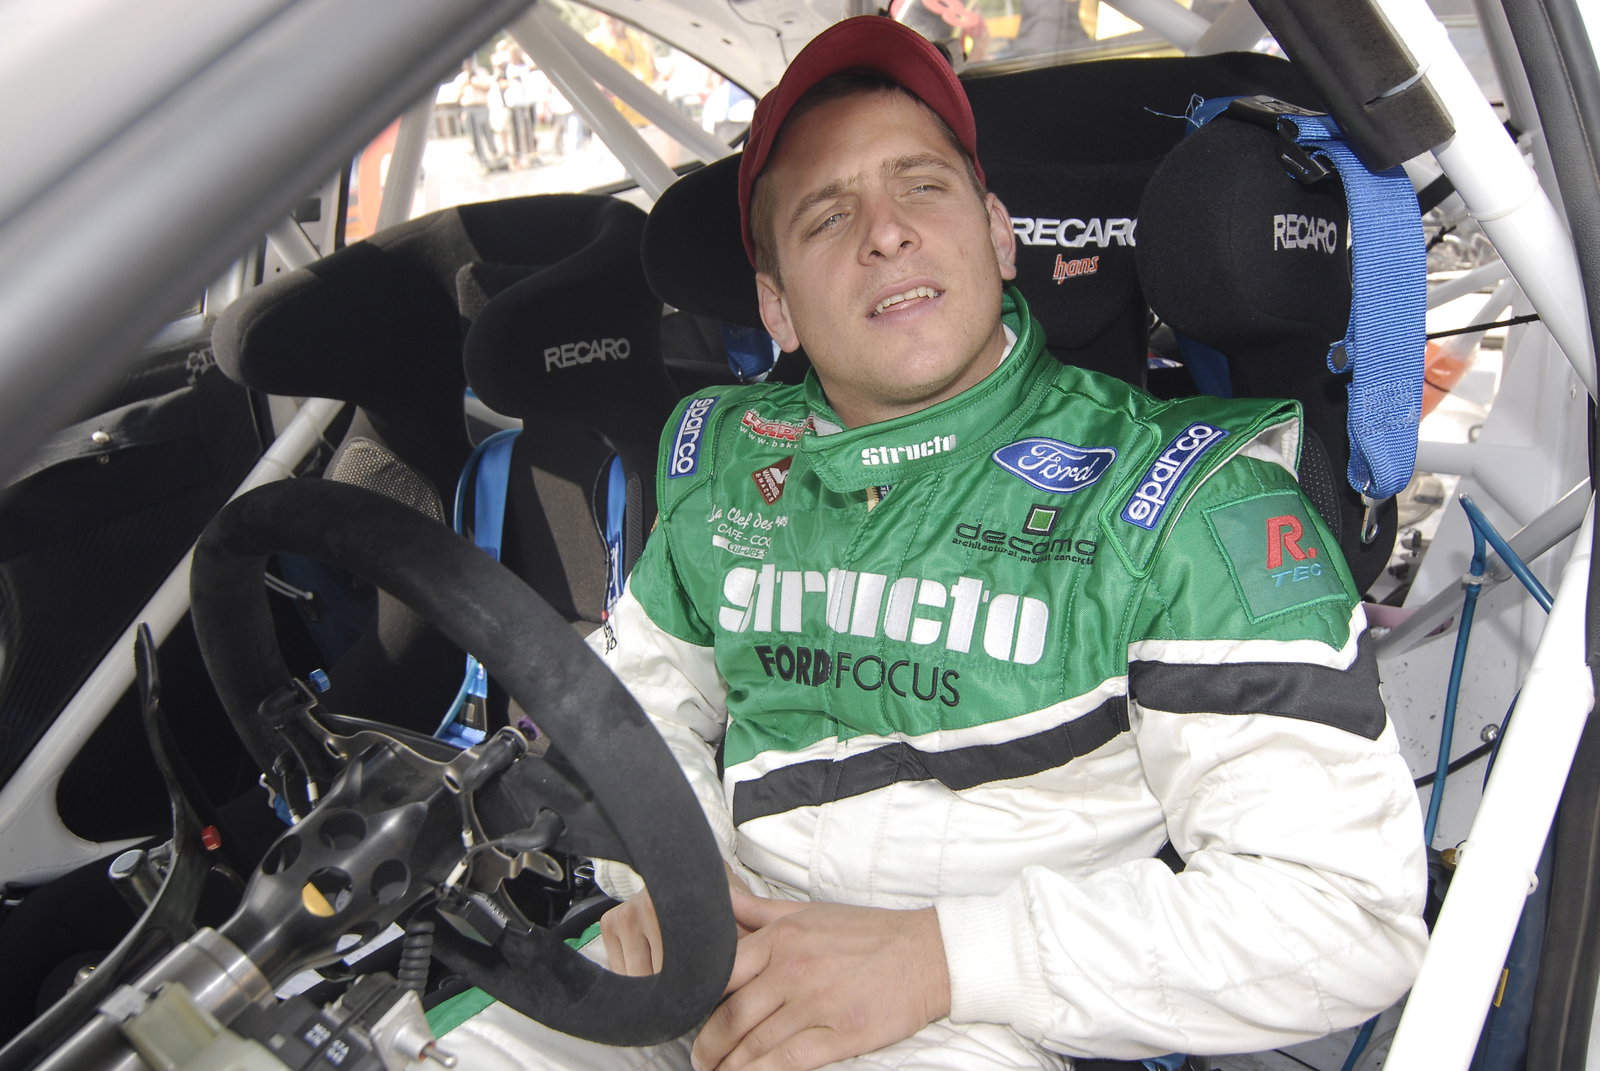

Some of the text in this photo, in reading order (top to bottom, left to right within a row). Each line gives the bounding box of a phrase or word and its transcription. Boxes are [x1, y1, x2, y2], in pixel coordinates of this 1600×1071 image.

[1273, 213, 1337, 254] RECARO
[1052, 253, 1100, 285] hans
[543, 337, 631, 372] RECARO
[672, 398, 715, 475] sparco
[861, 434, 957, 466] structo
[1017, 444, 1101, 481] Ford
[1127, 424, 1220, 526] sparco
[717, 523, 744, 542] CAFE
[727, 507, 753, 530] Clef
[753, 512, 774, 531] des
[718, 563, 1050, 666] structo
